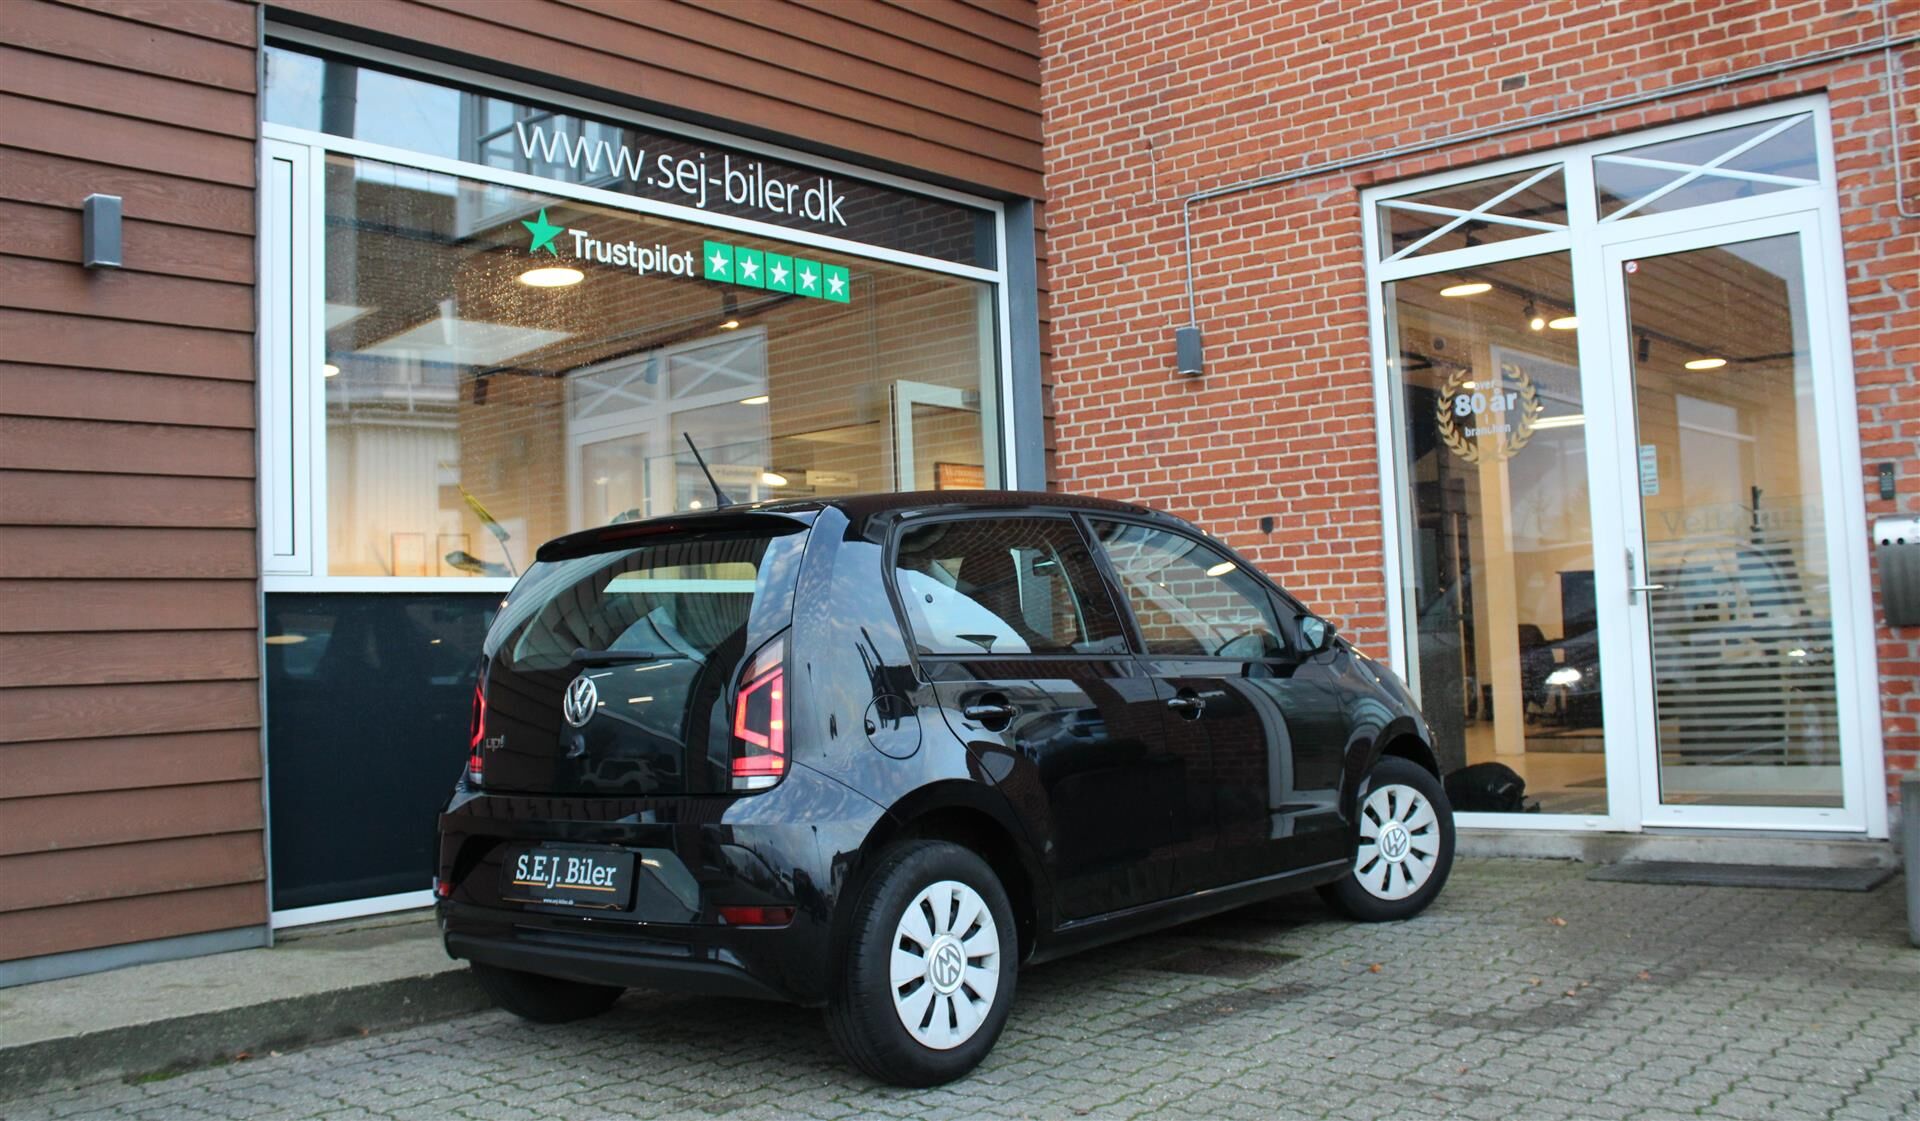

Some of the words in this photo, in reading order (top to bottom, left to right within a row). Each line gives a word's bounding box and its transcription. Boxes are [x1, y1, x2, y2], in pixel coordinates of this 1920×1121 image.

[516, 121, 847, 226] www.sej-biler.dk
[568, 228, 695, 277] Trustpilot
[1455, 392, 1487, 417] 80
[515, 854, 561, 889] S.E.J.
[565, 857, 616, 887] Biler
